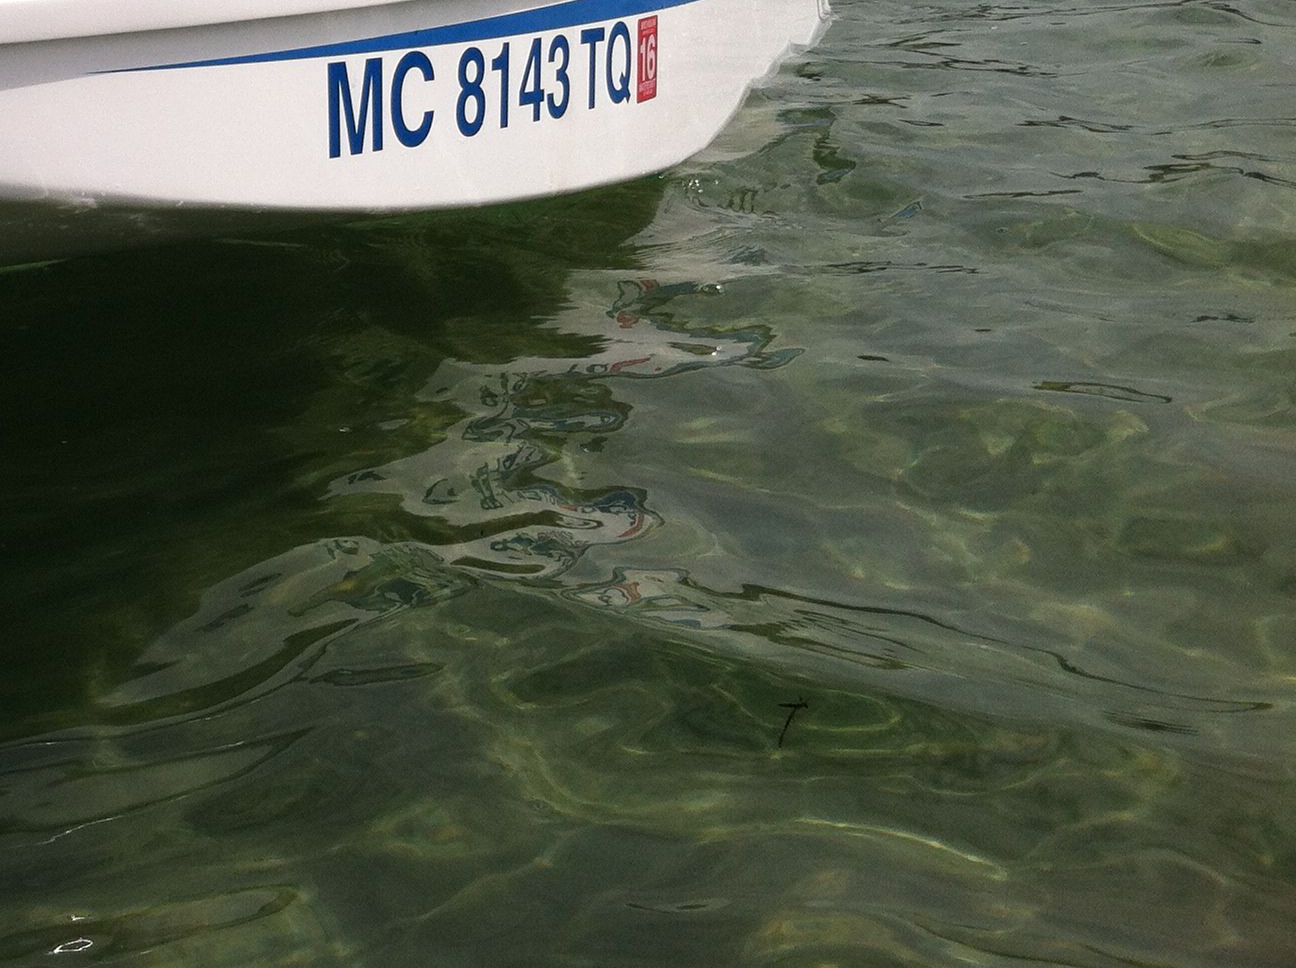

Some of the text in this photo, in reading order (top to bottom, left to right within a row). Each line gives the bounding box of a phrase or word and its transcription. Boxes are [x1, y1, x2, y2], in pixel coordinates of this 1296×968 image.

[327, 21, 632, 159] MC 8143 TQ
[640, 34, 656, 81] 16
